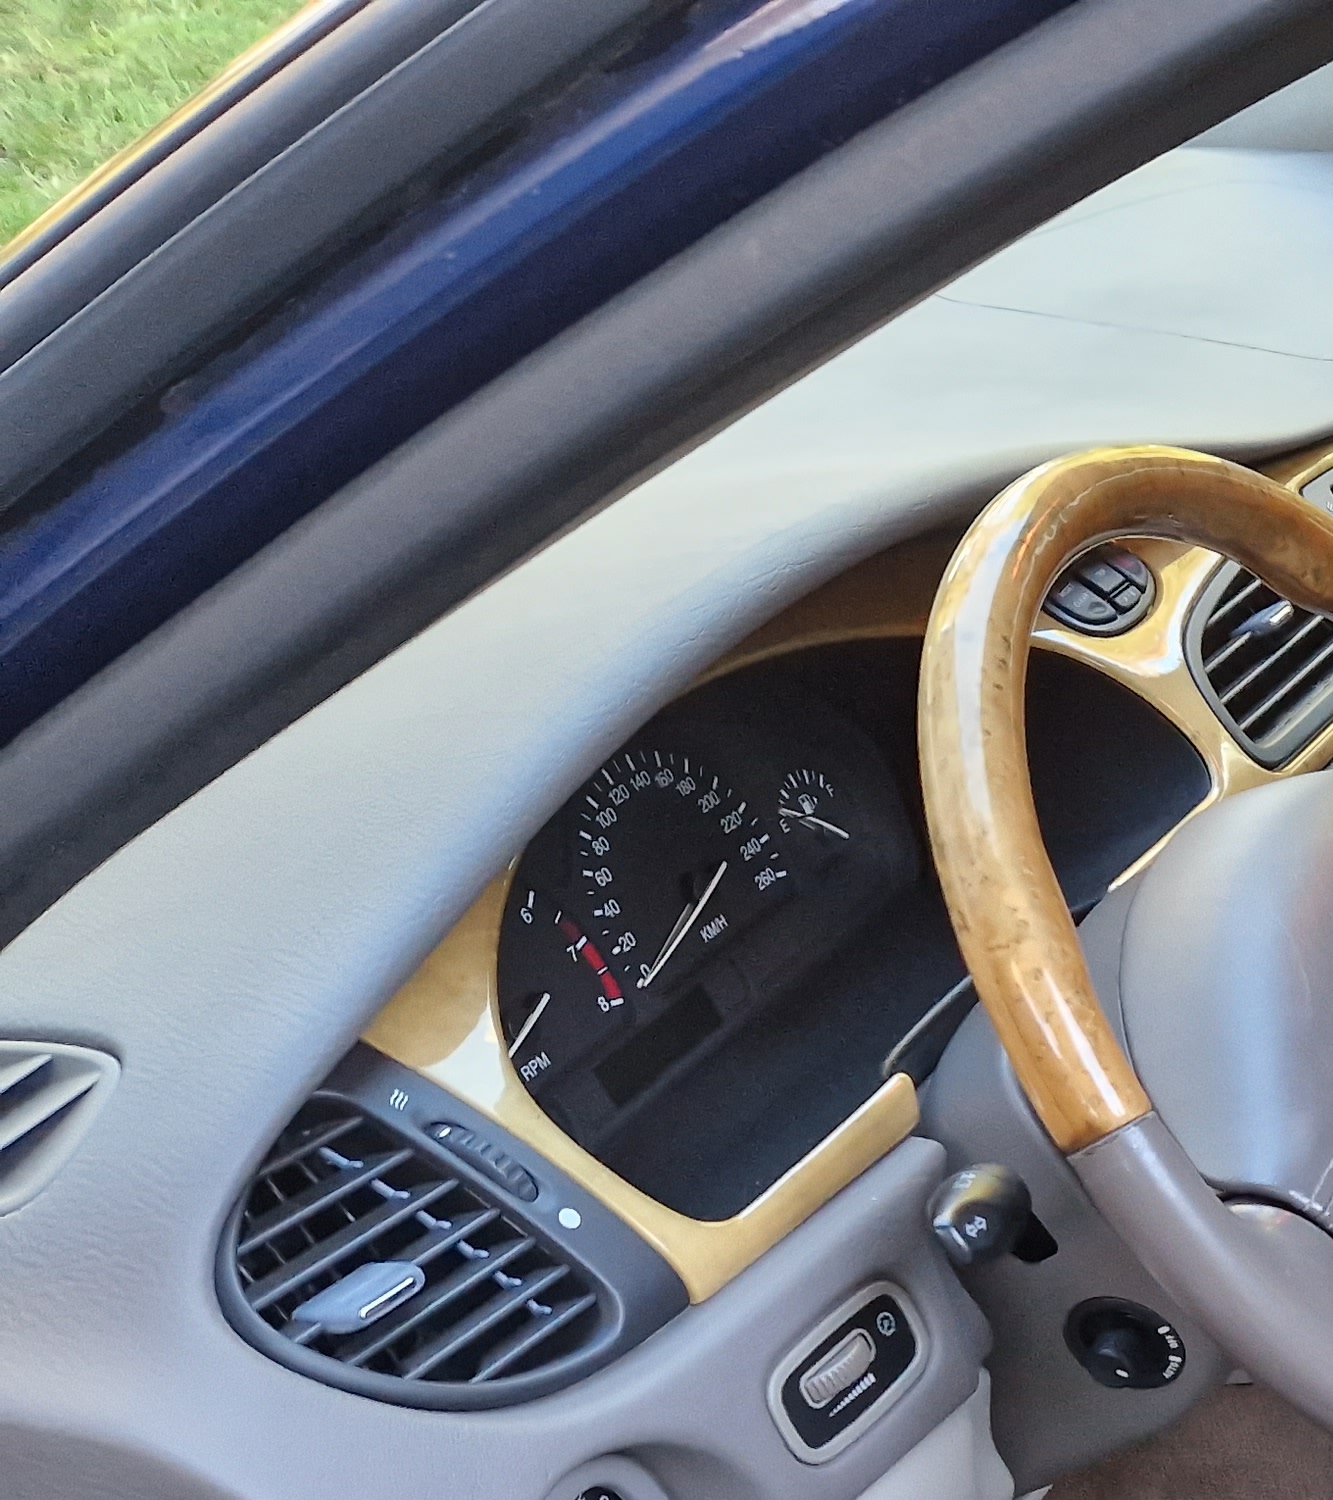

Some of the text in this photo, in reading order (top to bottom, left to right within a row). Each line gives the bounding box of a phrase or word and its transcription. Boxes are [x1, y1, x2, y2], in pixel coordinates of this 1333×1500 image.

[629, 771, 652, 792] 140
[654, 768, 675, 789] 160
[675, 776, 697, 797] 180
[608, 785, 631, 805] 120
[824, 784, 835, 798] F
[697, 791, 721, 814] 200
[594, 807, 618, 829] 100
[719, 811, 744, 834] 220
[779, 819, 791, 834] E
[591, 835, 611, 856] 80
[738, 837, 762, 862] 240
[593, 866, 614, 887] 60
[754, 867, 778, 891] 260
[519, 907, 534, 924] 6
[602, 898, 621, 918] 40
[699, 914, 729, 943] KM/H
[617, 931, 637, 952] 20
[566, 944, 579, 962] 7
[596, 996, 610, 1012] 8
[519, 1051, 552, 1083] RPM
